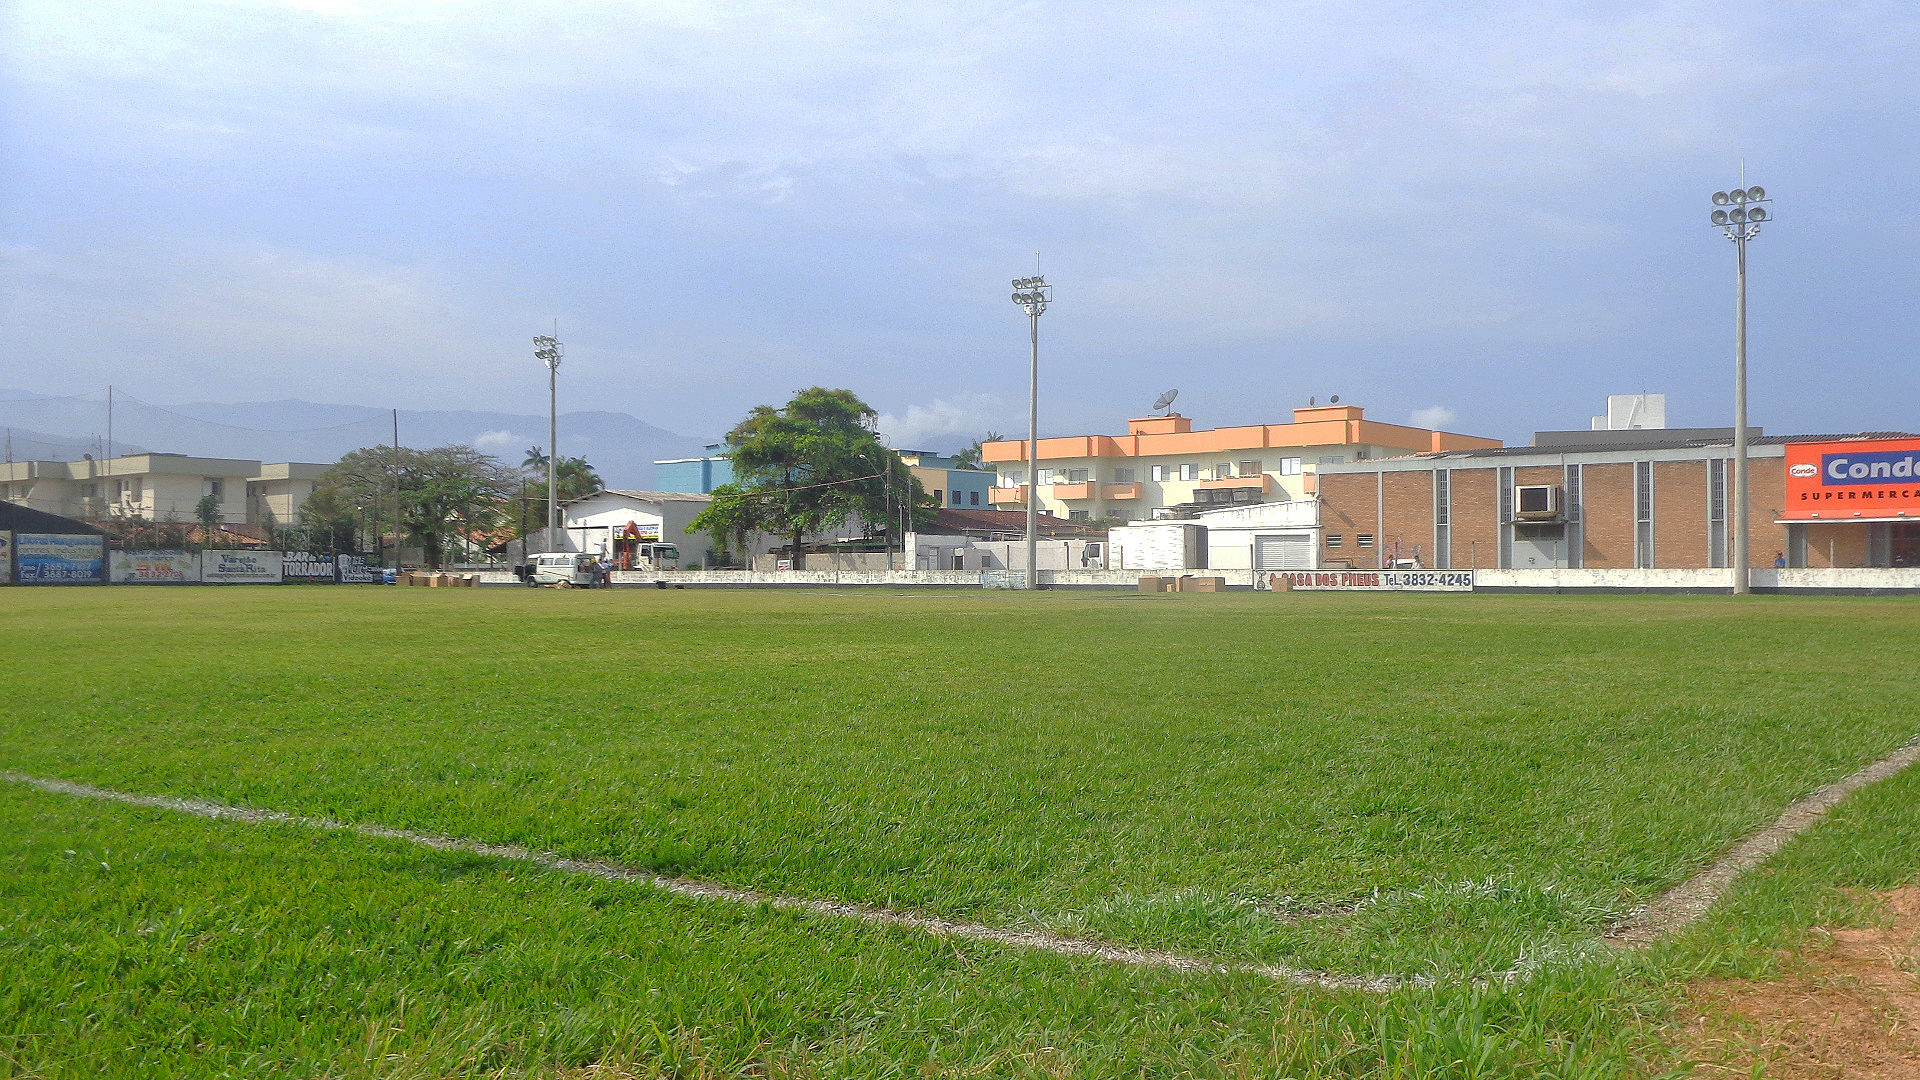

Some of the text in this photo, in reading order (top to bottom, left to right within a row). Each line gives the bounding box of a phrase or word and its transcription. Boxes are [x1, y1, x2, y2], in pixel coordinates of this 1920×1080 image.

[1791, 467, 1815, 475] Conde
[282, 551, 309, 561] BAR
[283, 562, 333, 576] TORRADOR
[1315, 573, 1338, 586] DOS
[1341, 573, 1380, 586] PNEUS
[1402, 573, 1471, 586] 3832-4245
